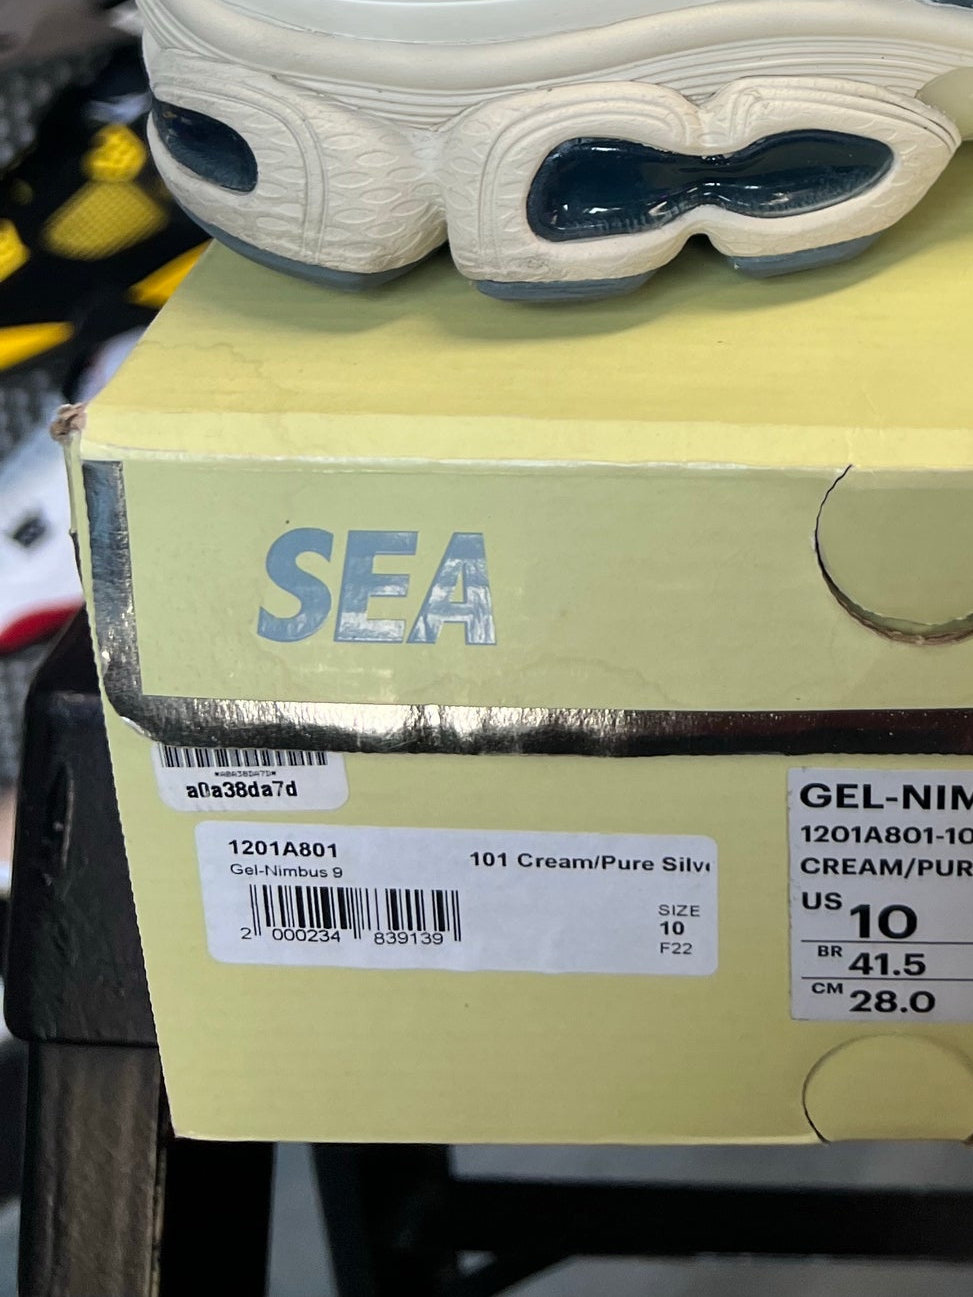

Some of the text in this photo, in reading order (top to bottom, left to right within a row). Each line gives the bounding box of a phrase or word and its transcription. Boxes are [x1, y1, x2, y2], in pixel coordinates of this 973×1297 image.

[257, 527, 497, 645] SEA
[186, 780, 298, 798] a0a38da7d
[228, 839, 338, 858] 1201A801
[230, 863, 343, 878] Gel-Nimbus 9
[470, 851, 508, 867] 101
[517, 852, 655, 872] Cream/Pure
[801, 892, 843, 910] US
[658, 904, 700, 918] SIZE
[659, 920, 685, 935] 10
[849, 903, 918, 939] 10
[240, 927, 444, 945] 2 000234 839139
[659, 942, 693, 955] F22
[817, 945, 843, 958] BR
[848, 952, 927, 976] 41.5
[811, 982, 844, 994] CM
[849, 989, 936, 1013] 28.0
